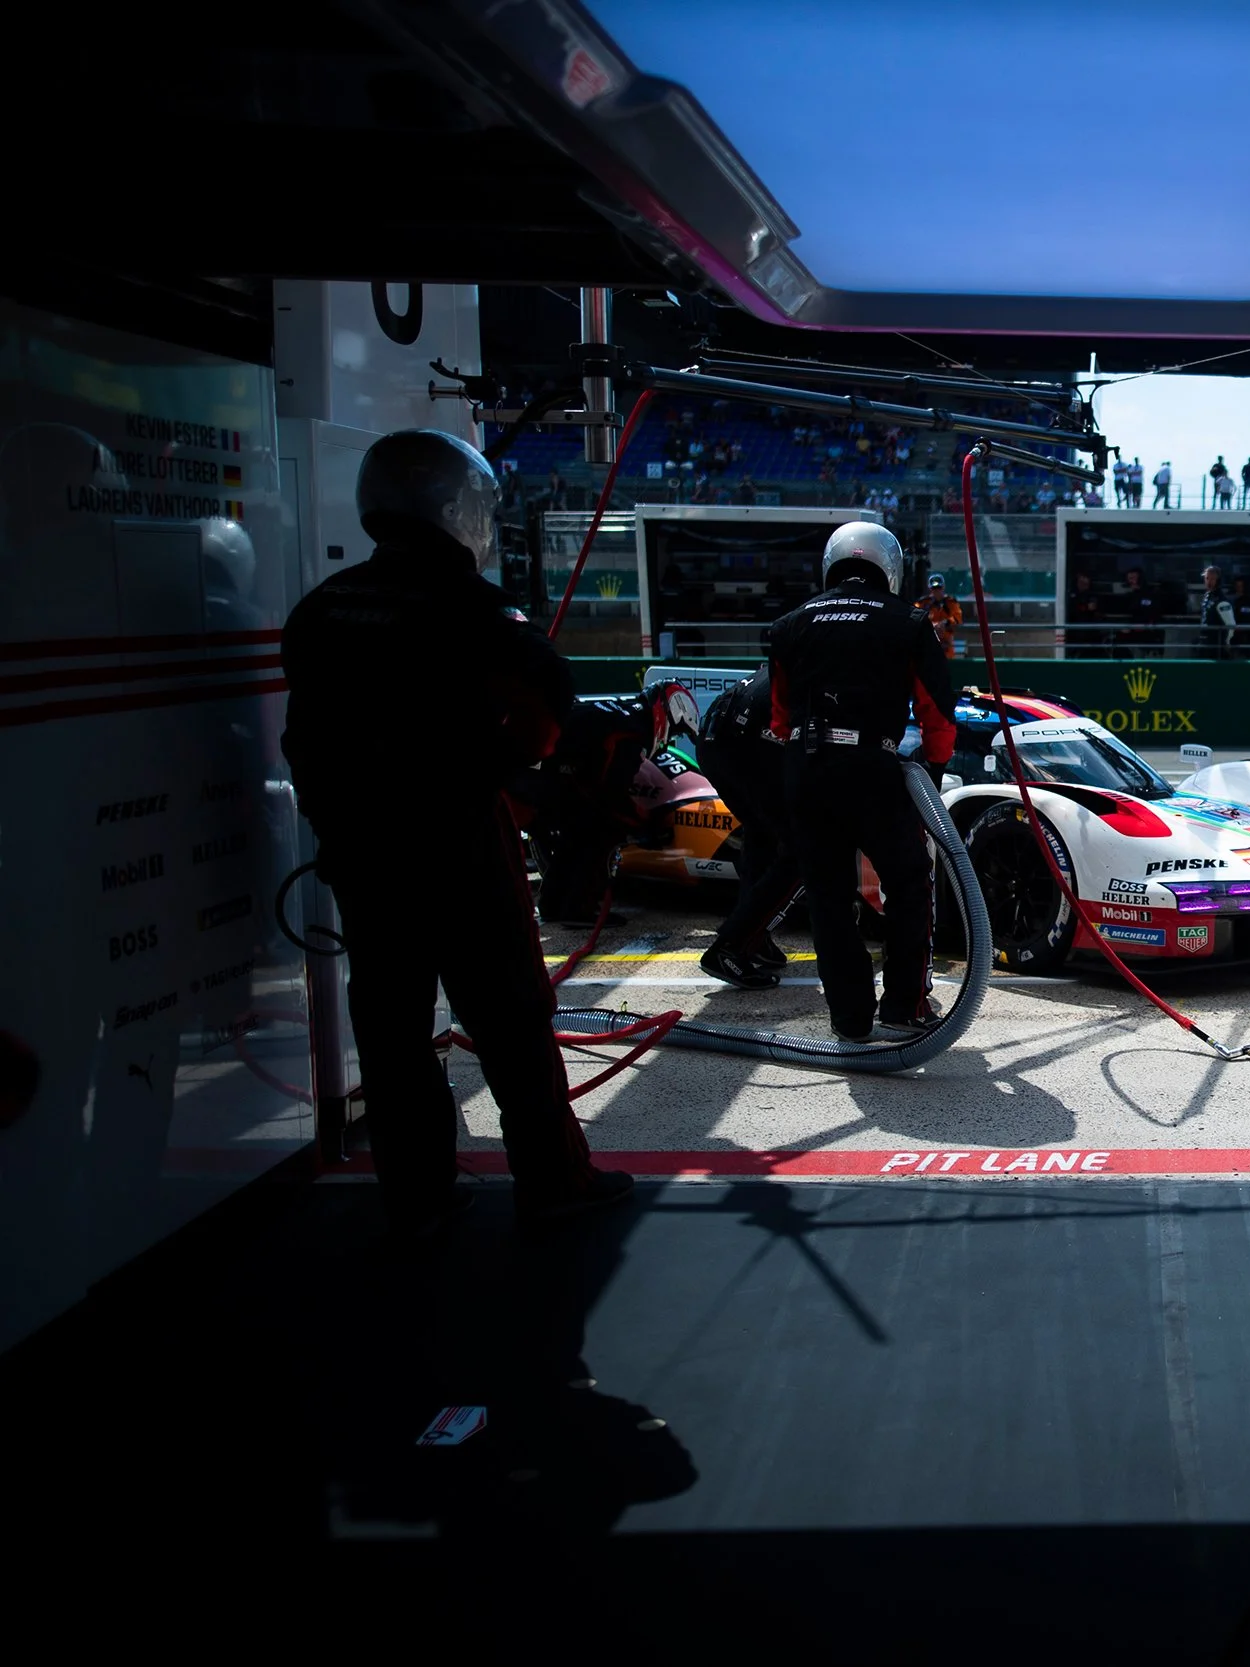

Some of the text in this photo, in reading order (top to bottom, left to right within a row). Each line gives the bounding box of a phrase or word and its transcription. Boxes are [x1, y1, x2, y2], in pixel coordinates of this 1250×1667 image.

[126, 413, 217, 450] KEVIN ESTRE
[150, 455, 218, 485] LOTTERER
[67, 484, 221, 520] LAURENS VANTHOOR
[805, 598, 885, 609] PORSCHE
[812, 612, 870, 623] PENSKE
[1183, 749, 1209, 757] HELLER
[96, 793, 170, 825] PENSKE
[675, 811, 733, 831] HELLER
[102, 857, 147, 892] Mobil
[1145, 858, 1228, 876] PENSKE
[1111, 880, 1144, 893] BOSS
[1102, 892, 1150, 905] HELLER
[1102, 906, 1151, 922] Mobil 1
[1112, 930, 1159, 941] MICHELIN
[1180, 928, 1206, 937] TAG
[109, 925, 158, 962] BOSS
[1179, 937, 1207, 950] HEUER
[880, 1153, 1111, 1172] PIT LANE
